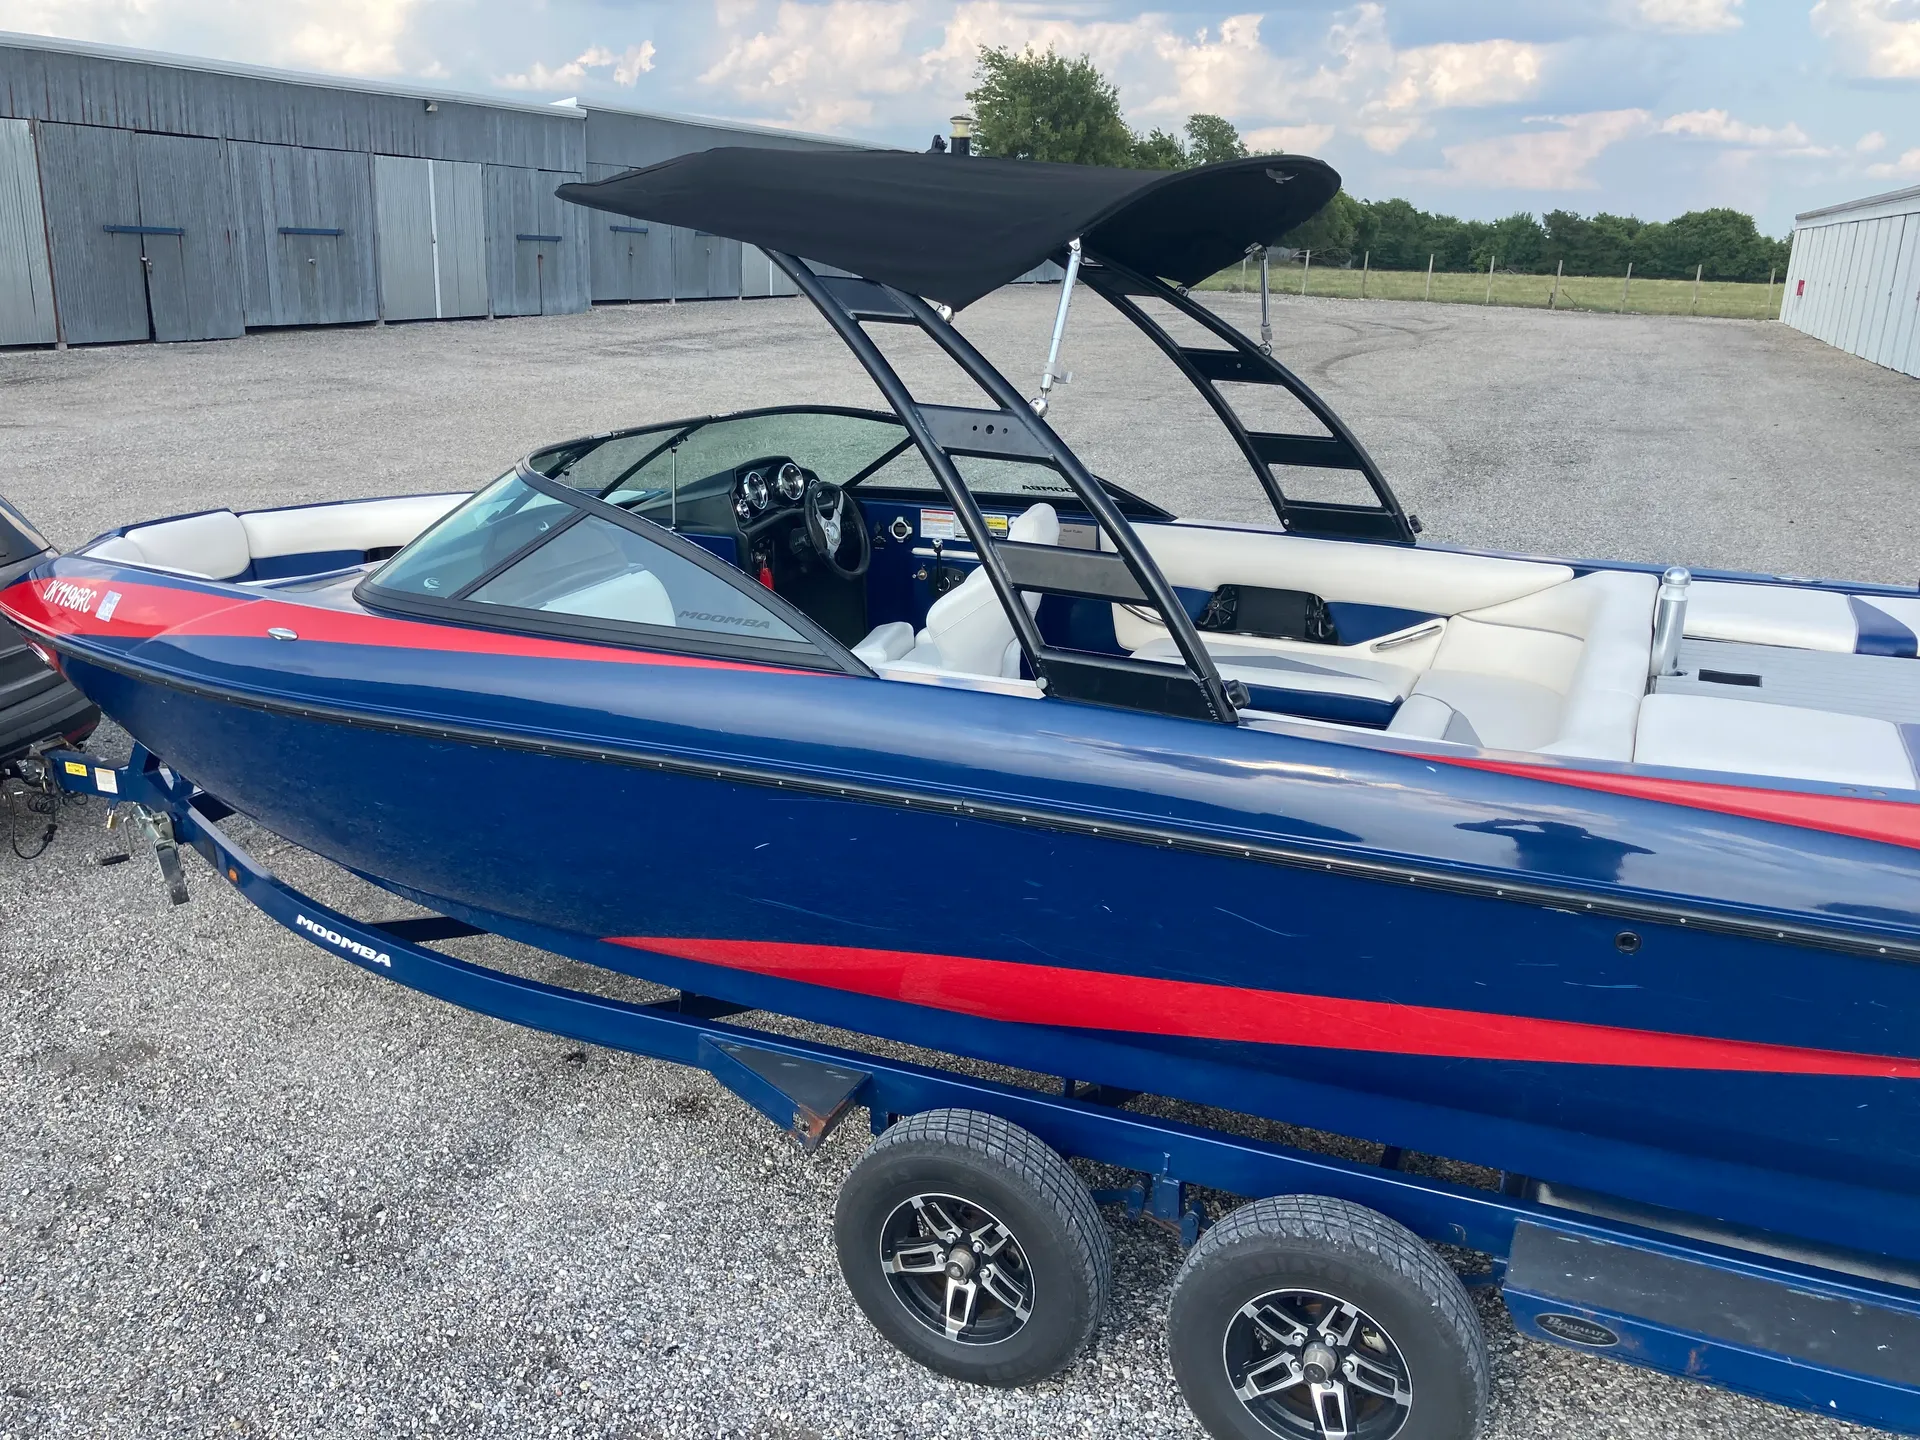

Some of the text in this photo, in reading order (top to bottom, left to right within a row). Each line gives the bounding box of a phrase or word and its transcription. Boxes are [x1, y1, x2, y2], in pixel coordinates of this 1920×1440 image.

[43, 579, 97, 613] OK1196RC
[678, 610, 770, 629] MOOMBA
[295, 914, 392, 968] MOOMBA
